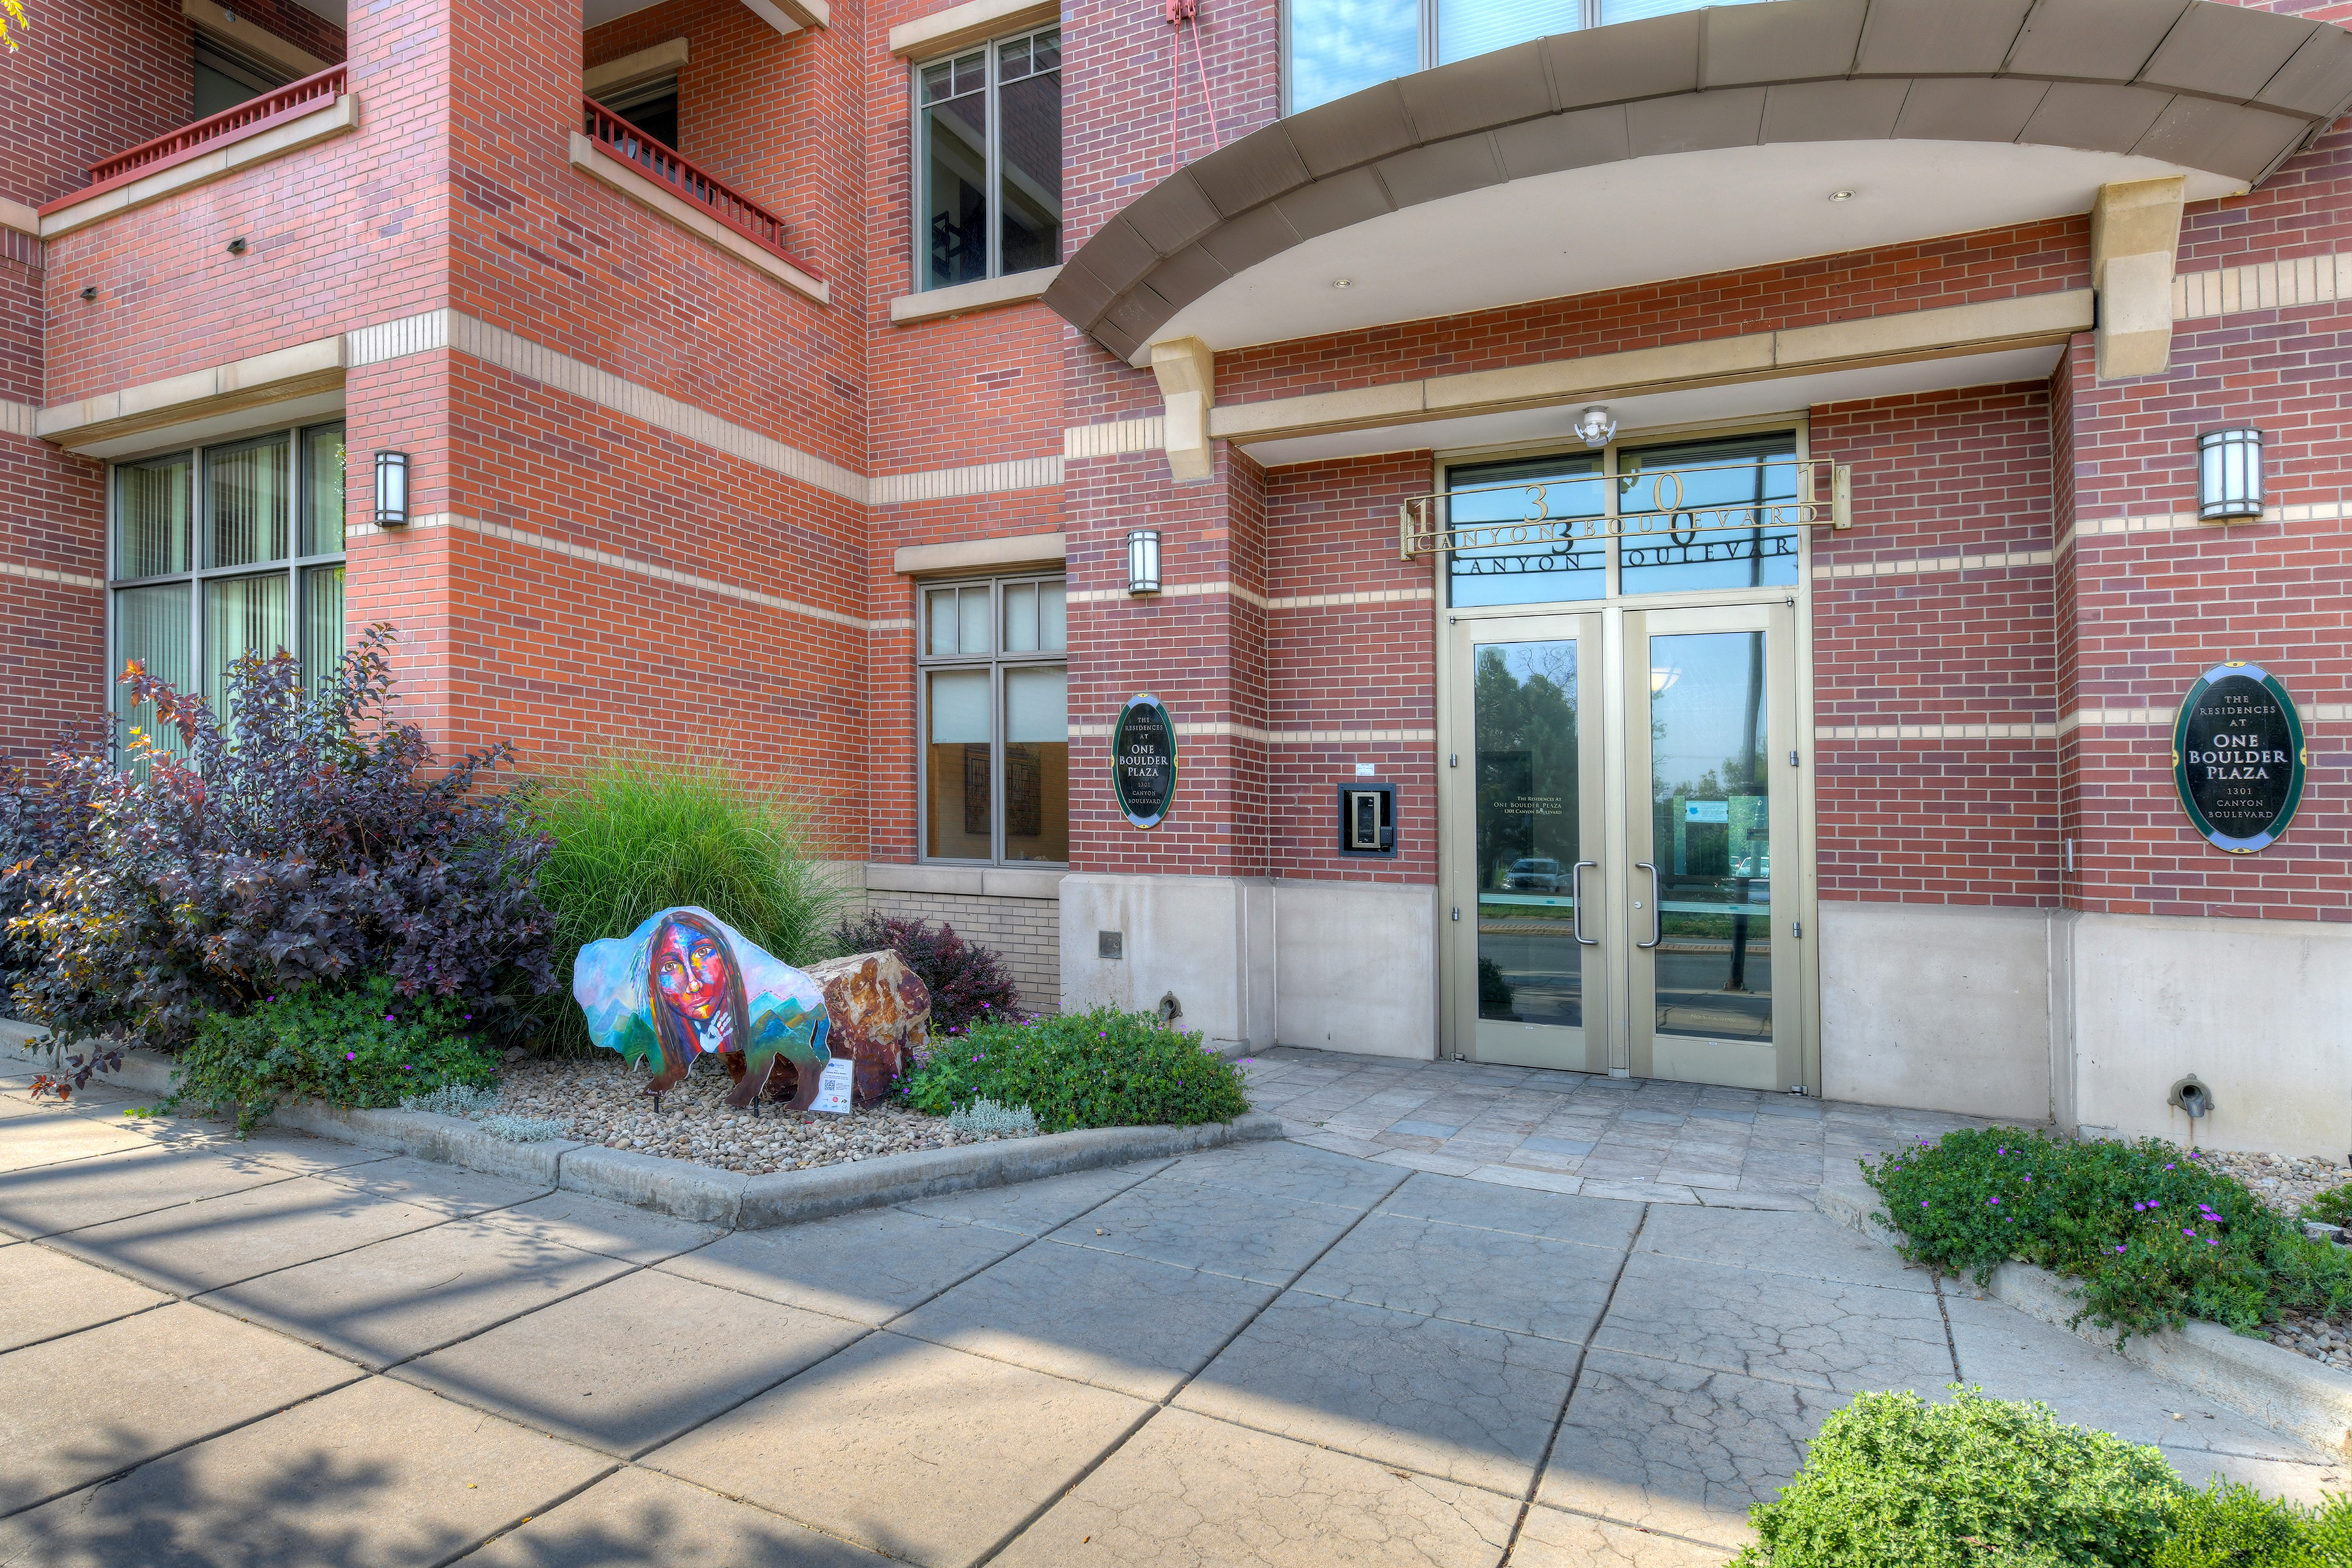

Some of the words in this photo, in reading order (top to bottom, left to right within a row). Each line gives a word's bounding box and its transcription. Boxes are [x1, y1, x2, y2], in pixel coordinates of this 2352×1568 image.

[1416, 523, 1555, 551] CANYON
[1583, 505, 1818, 537] BOULEVARD
[2199, 706, 2276, 715] RESIDENCES
[2213, 734, 2259, 747] ONE
[1131, 744, 1154, 755] ONE
[1119, 756, 1169, 765] BOULDER
[2189, 750, 2288, 764] BOULDER
[1128, 768, 1159, 777] PLAZA
[2206, 766, 2270, 779] PLAZA
